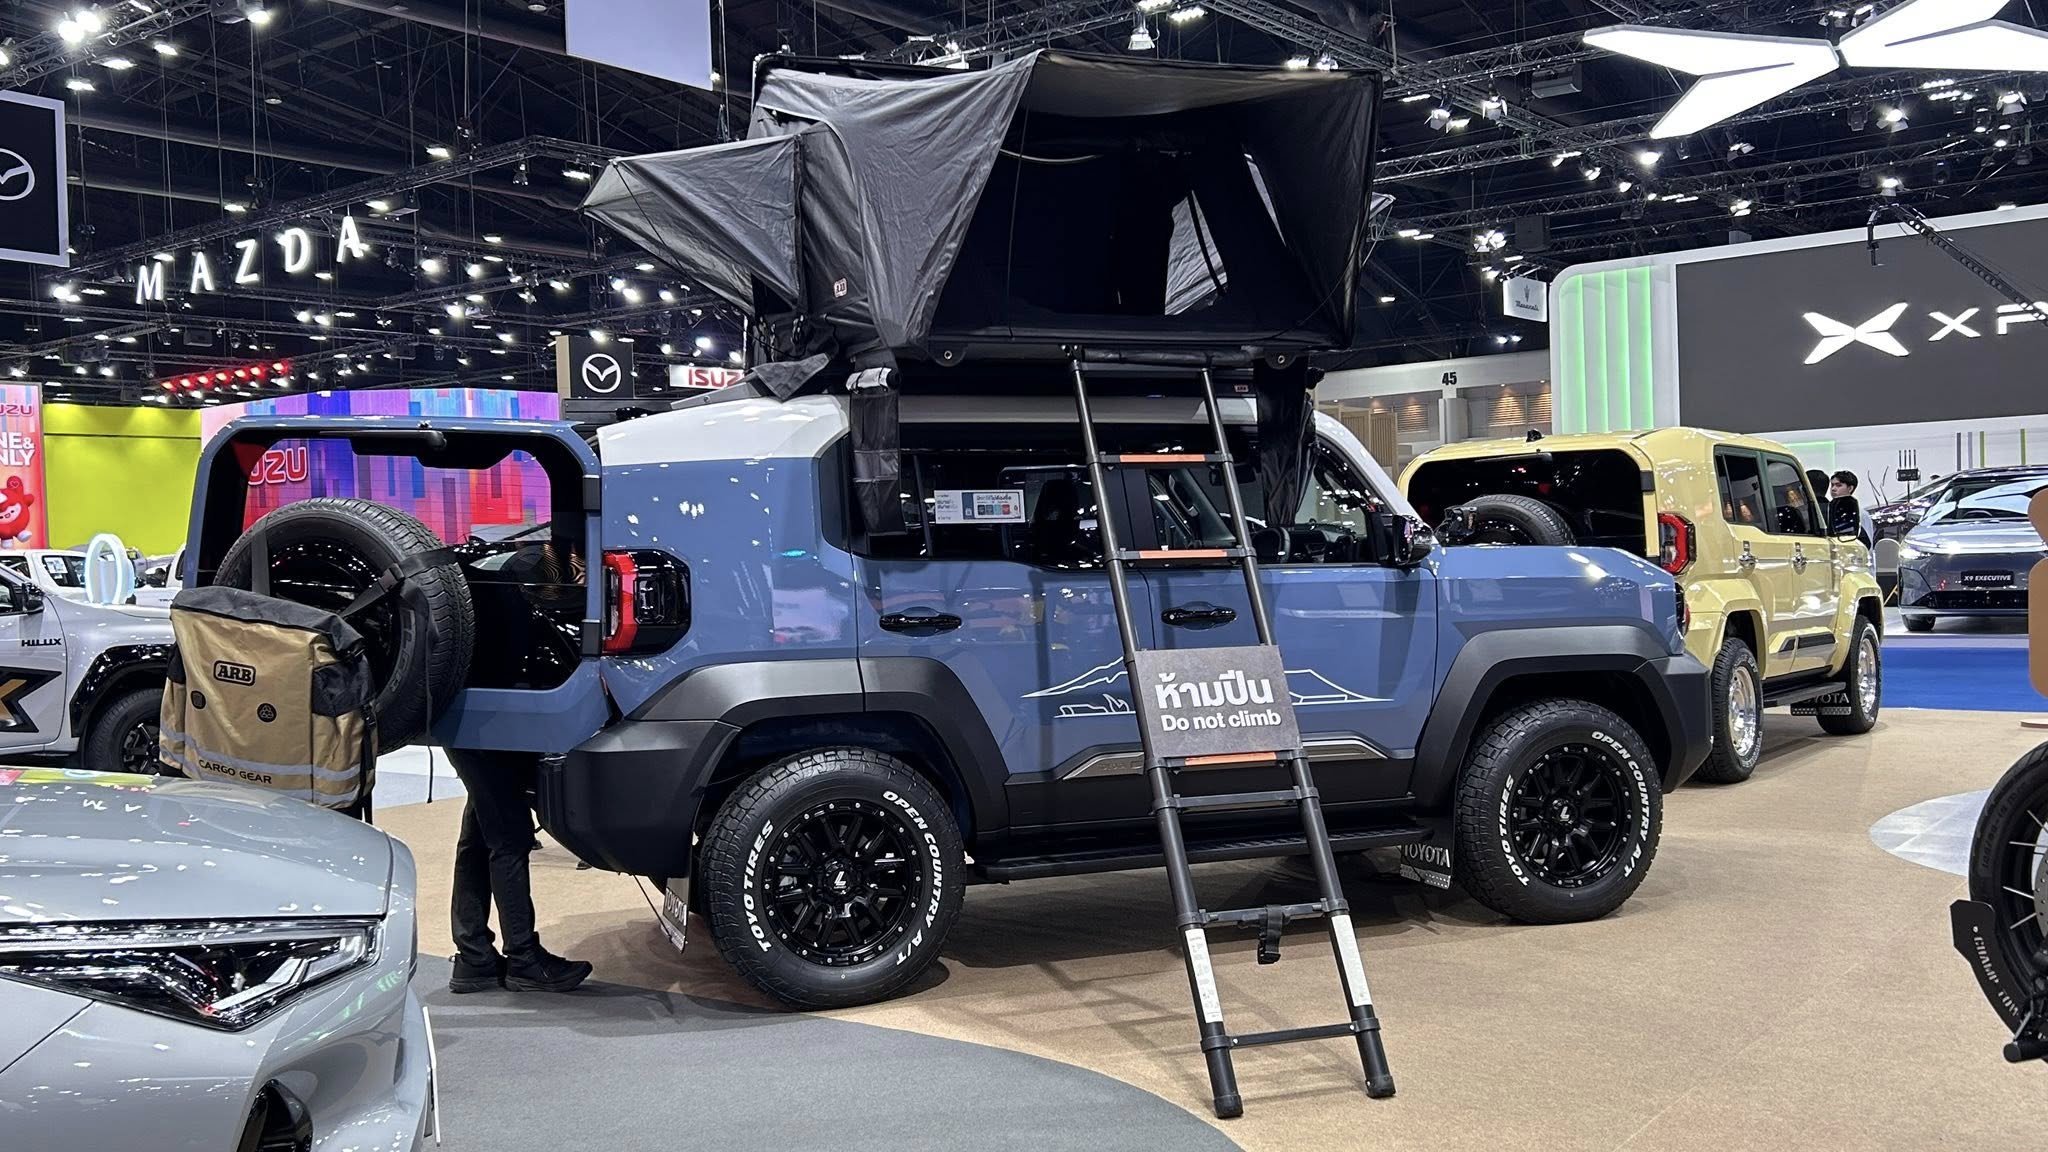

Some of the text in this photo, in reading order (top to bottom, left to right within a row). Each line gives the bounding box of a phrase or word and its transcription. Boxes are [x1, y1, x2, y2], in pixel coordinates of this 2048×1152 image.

[136, 215, 364, 305] MAZDA
[1441, 371, 1457, 385] 45
[21, 638, 62, 647] HILUX
[217, 664, 252, 681] ARB
[1155, 669, 1275, 709] ห้ามปีน
[1160, 709, 1282, 732] Do not climb
[198, 759, 272, 784] CARGO GEAR
[1591, 731, 1650, 878] OPEN COUNTRY A/T
[1499, 774, 1530, 886] TOYO TIRES
[743, 819, 774, 952] TOYO TIRES
[882, 790, 943, 965] OPEN COUNTRY A/T
